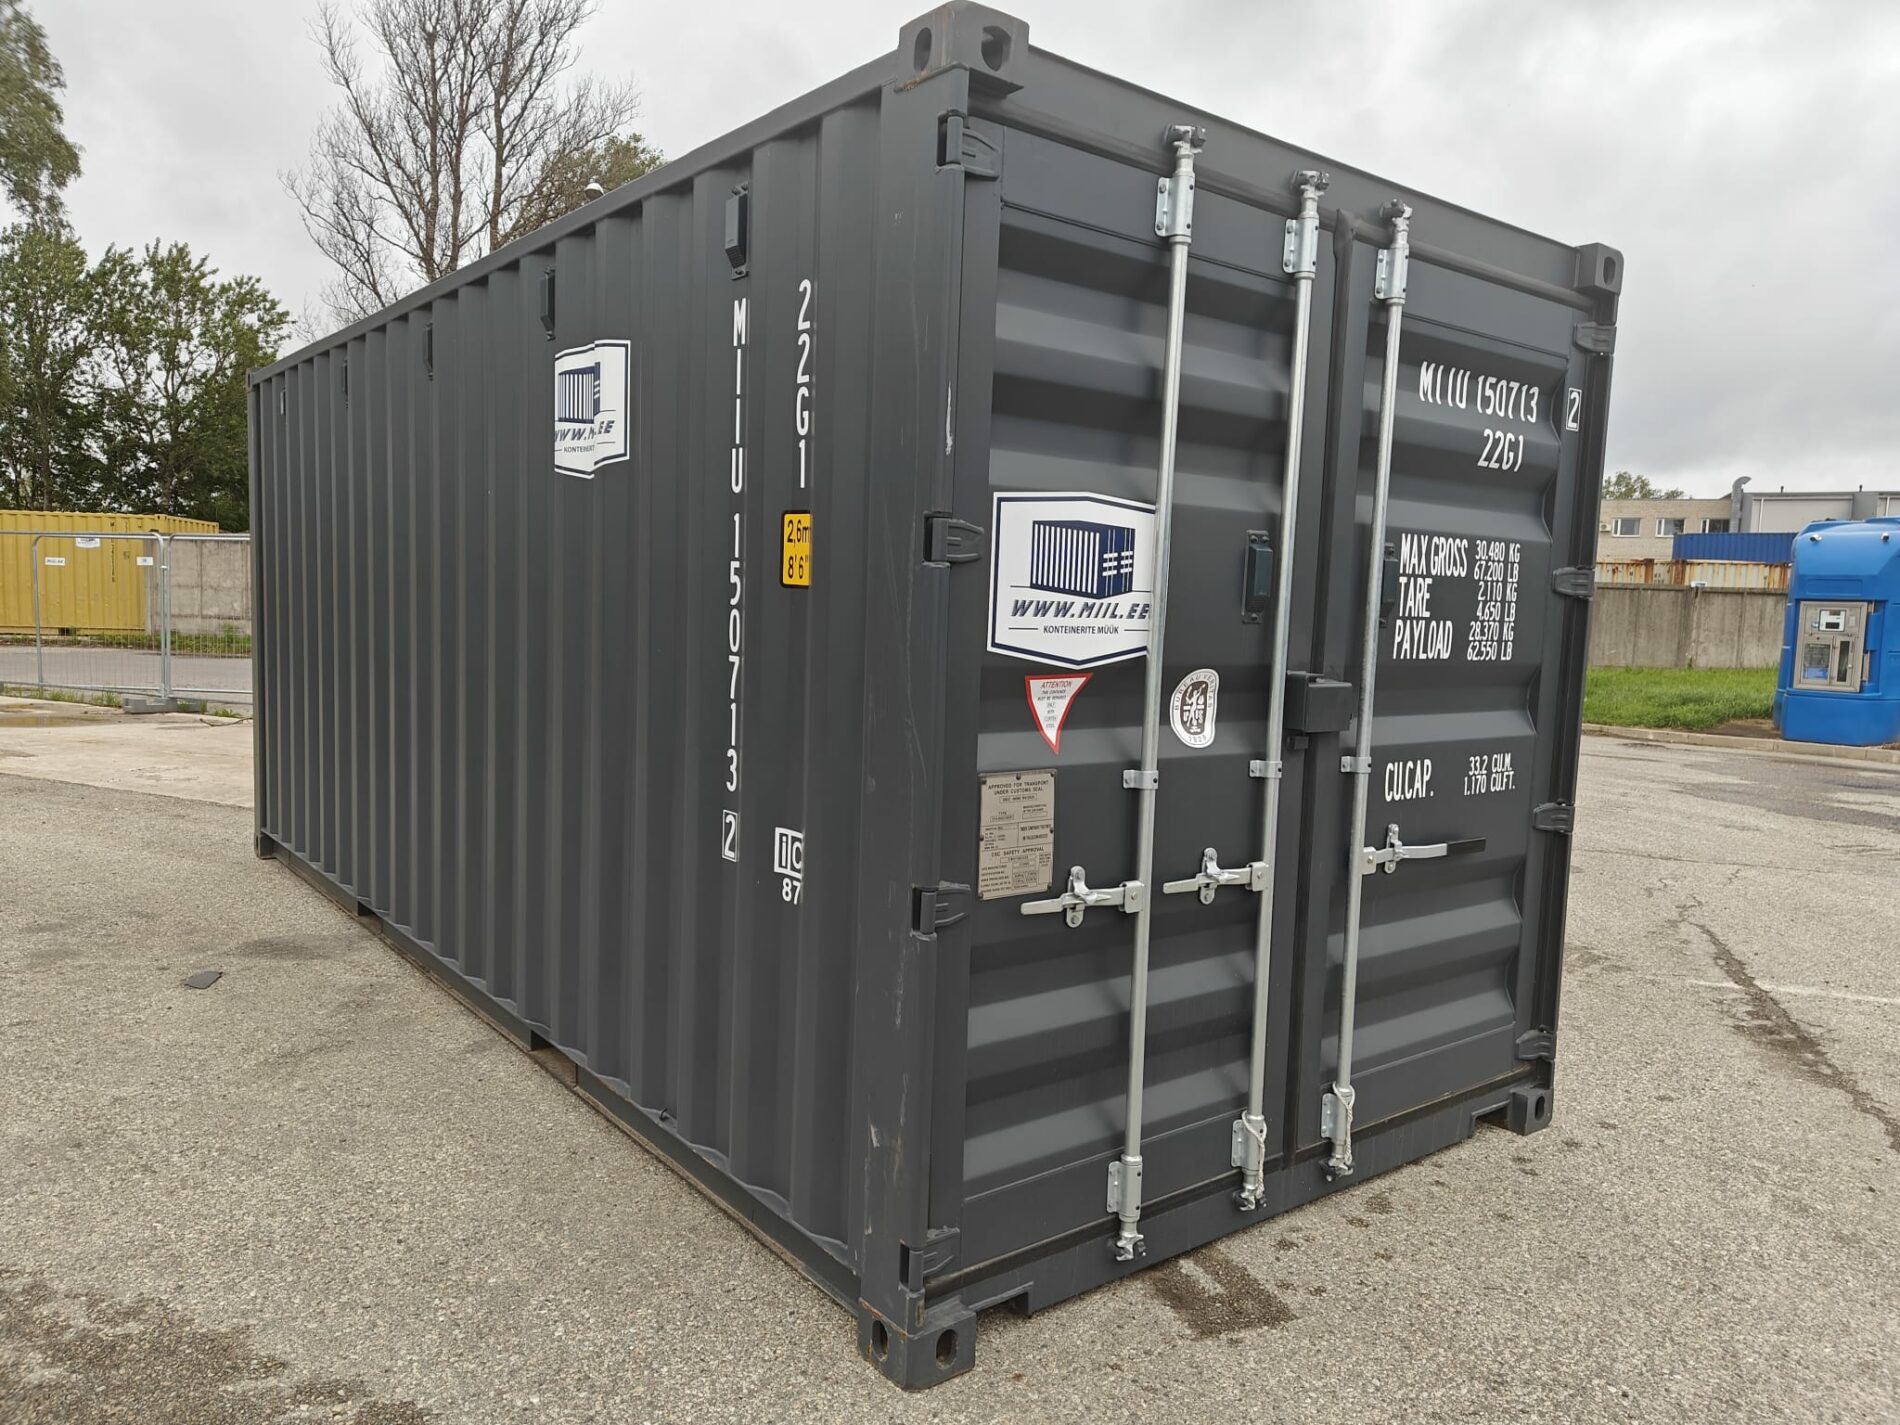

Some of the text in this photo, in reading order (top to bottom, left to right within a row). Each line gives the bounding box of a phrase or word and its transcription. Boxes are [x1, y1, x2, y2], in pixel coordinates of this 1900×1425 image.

[797, 279, 811, 488] 22G1
[1419, 361, 1581, 430] MIIU 150713 2
[1477, 428, 1524, 472] 22G1
[1400, 533, 1468, 577] MAX GROSS
[1509, 543, 1521, 562] KG
[723, 298, 747, 861] MIIU 150713 2
[1507, 563, 1519, 582] LB
[1399, 577, 1433, 617] TARE
[1505, 582, 1518, 601] KG
[1011, 600, 1149, 619] WWW.MIIL.EE
[1504, 602, 1516, 621] LB
[1043, 625, 1119, 635] KONTEINERITE MÜÜK
[1393, 619, 1453, 660] PAYLOAD
[1502, 622, 1514, 641] KG
[1501, 642, 1513, 661] LB
[1468, 755, 1488, 776] 33.2
[1385, 759, 1434, 802] CU.CAP.
[782, 877, 801, 905] 87
